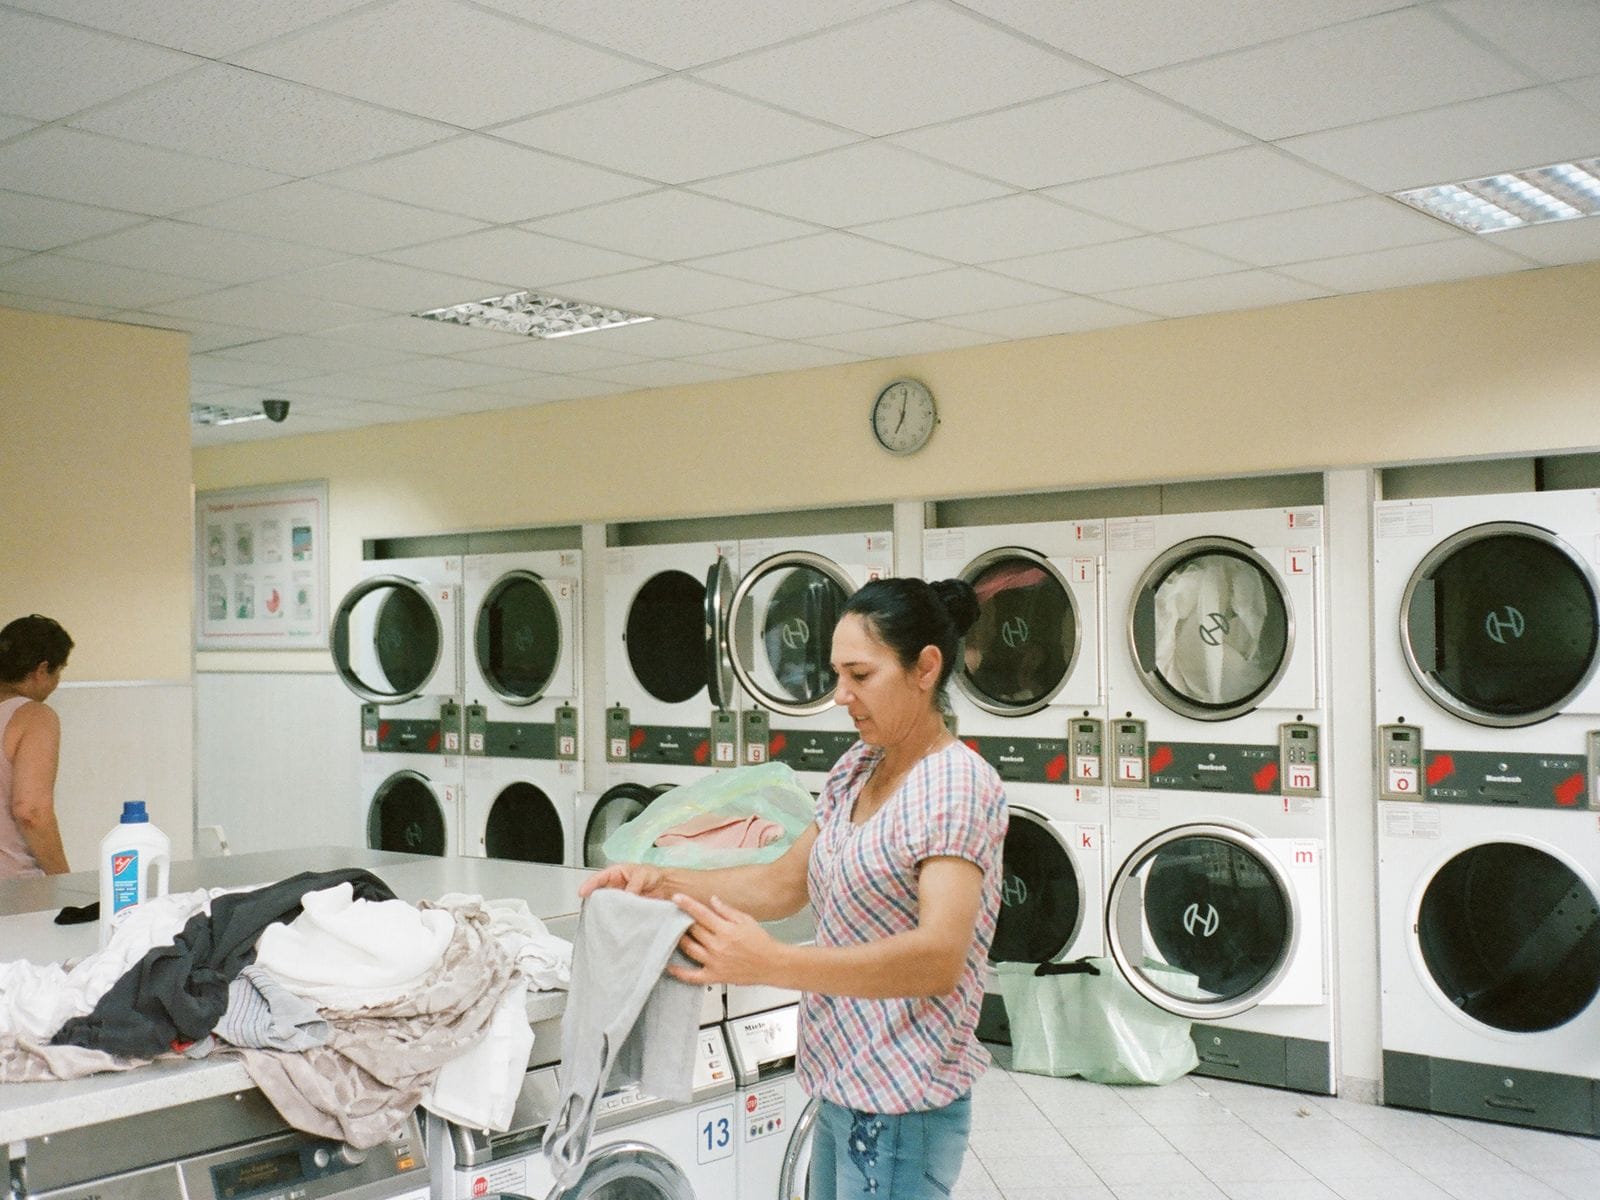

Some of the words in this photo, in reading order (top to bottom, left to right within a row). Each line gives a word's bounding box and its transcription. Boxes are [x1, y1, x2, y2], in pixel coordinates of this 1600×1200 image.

[1292, 557, 1303, 572] L
[1081, 565, 1085, 580] i
[442, 591, 448, 600] a
[448, 736, 455, 748] b
[474, 738, 480, 748] c
[564, 741, 571, 754] d
[615, 745, 622, 755] e
[722, 747, 729, 760] f
[753, 749, 761, 762] g
[1083, 763, 1092, 777] k
[1126, 765, 1136, 778] L
[1294, 774, 1310, 787] m
[1397, 778, 1409, 790] o
[446, 790, 452, 800] b
[1082, 833, 1091, 847] k
[1295, 851, 1313, 863] m
[703, 1118, 729, 1150] 13
